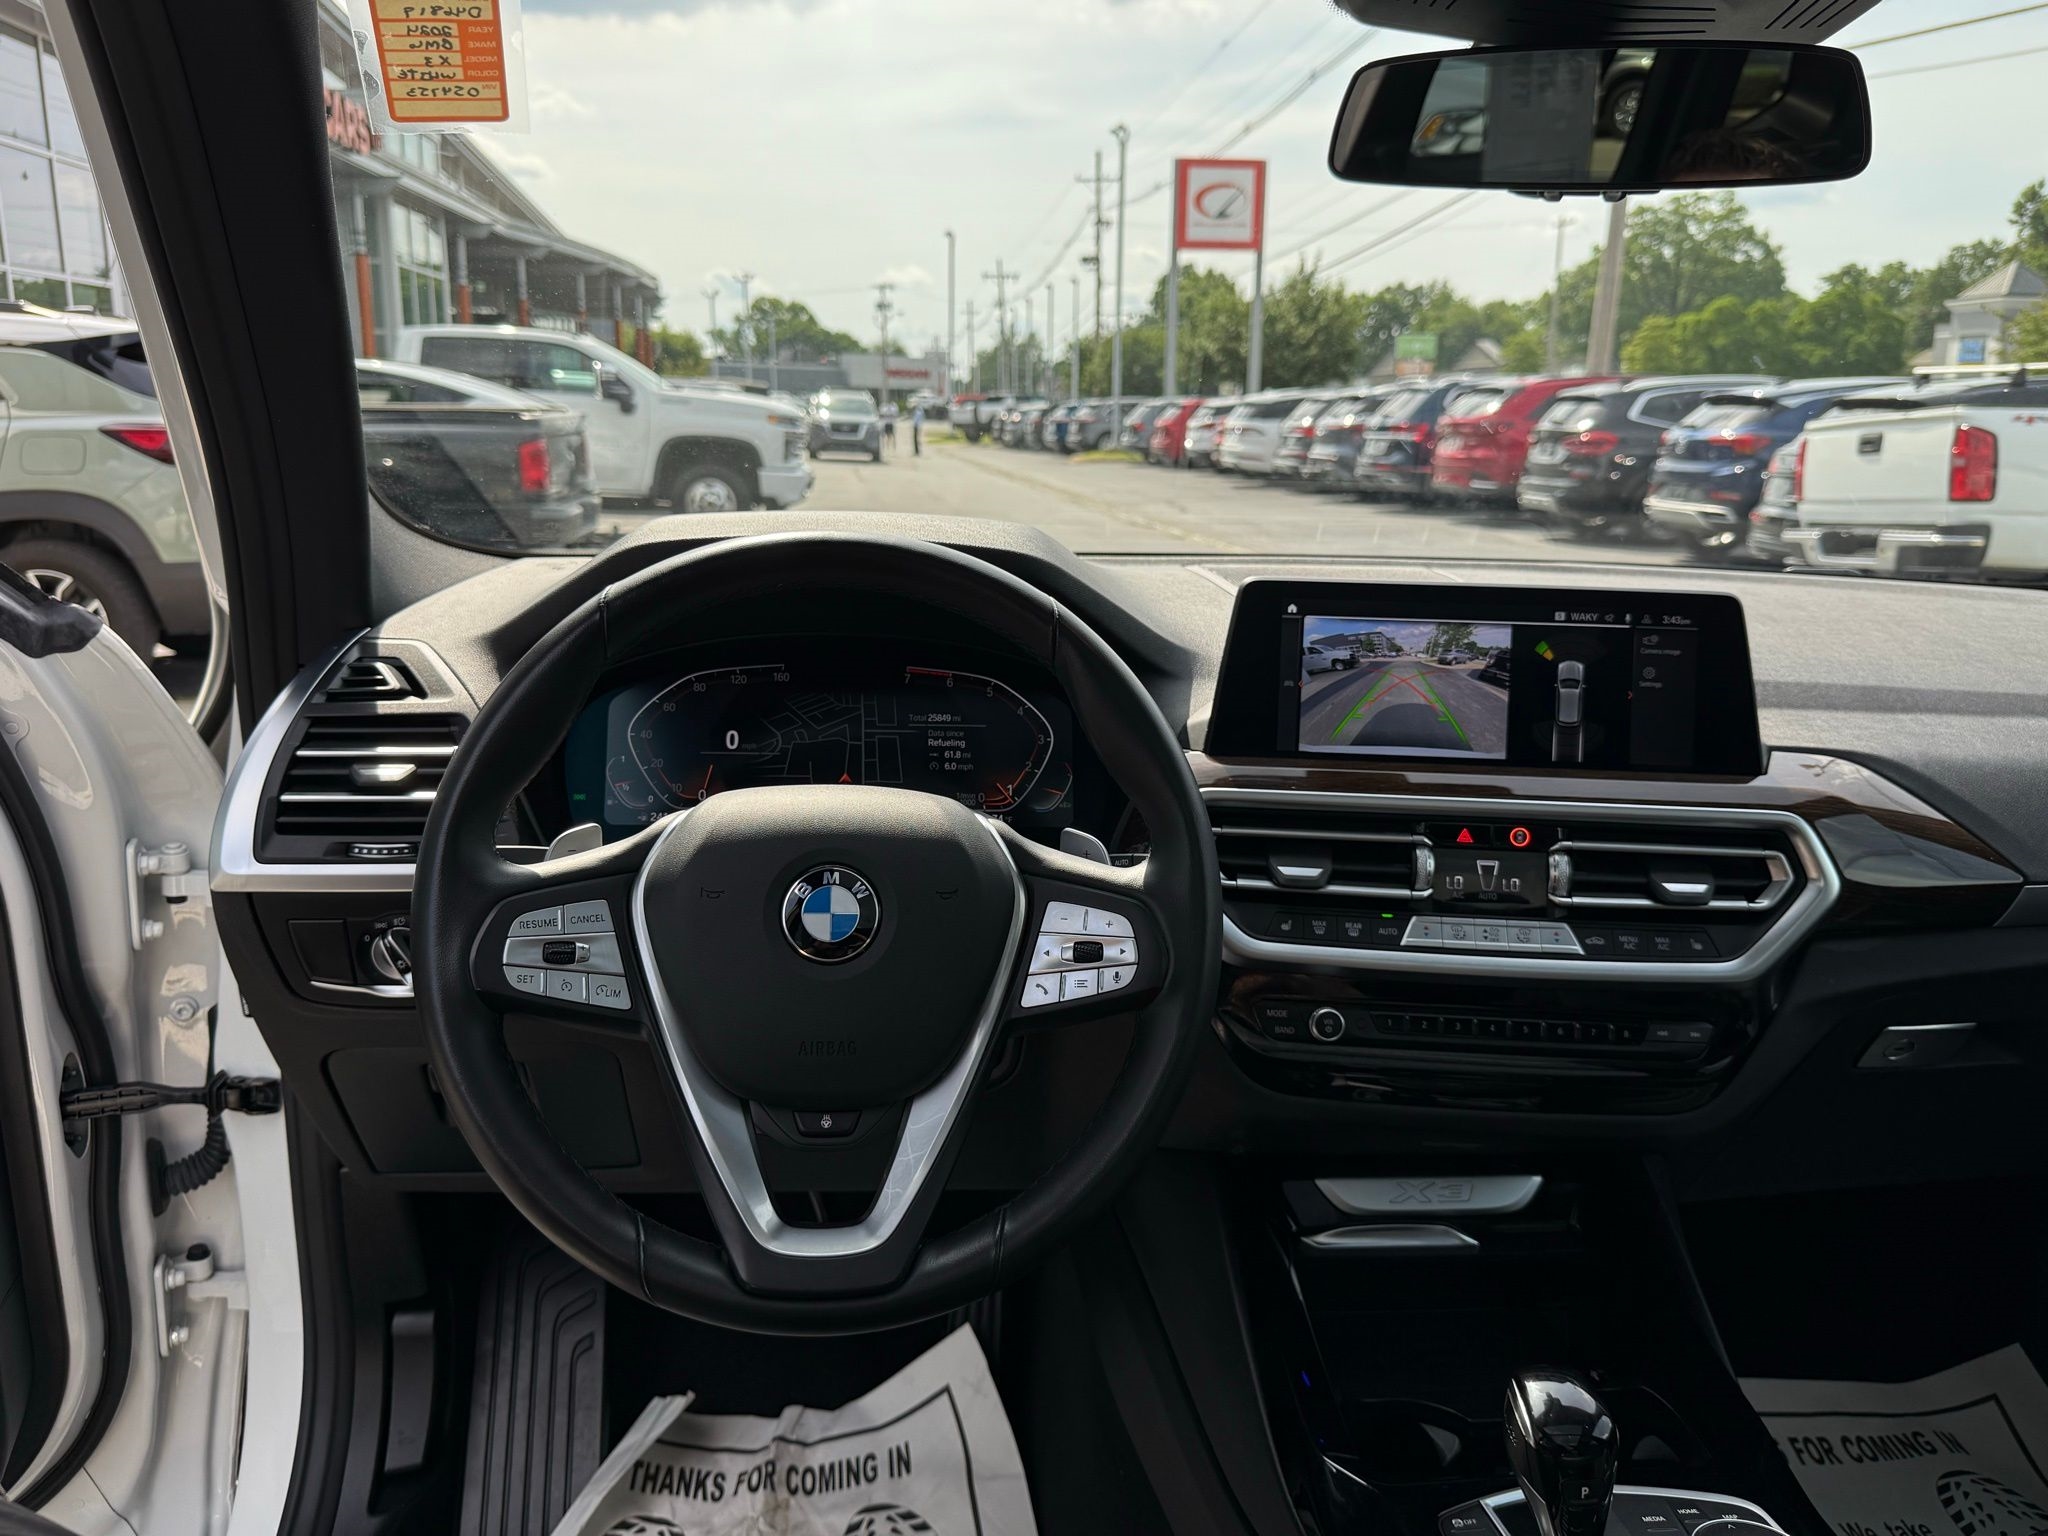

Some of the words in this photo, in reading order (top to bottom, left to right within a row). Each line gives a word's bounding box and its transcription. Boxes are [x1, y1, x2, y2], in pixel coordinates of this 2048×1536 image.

[1570, 612, 1597, 621] WAKY
[730, 675, 747, 684] 120
[773, 673, 790, 682] 160
[905, 674, 911, 684] 7
[693, 682, 706, 692] 80
[946, 679, 954, 687] 6
[986, 687, 994, 697] 5
[663, 703, 676, 712] 60
[1017, 706, 1024, 715] 4
[928, 713, 952, 722] 25849
[640, 730, 653, 739] 40
[725, 730, 740, 749] 0
[1037, 735, 1045, 744] 3
[928, 738, 966, 748] Refueling
[650, 758, 664, 768] 20
[944, 762, 957, 770] 6.0
[1025, 762, 1032, 770] 2
[672, 783, 682, 792] 10
[978, 793, 985, 803] 0
[794, 871, 870, 899] BMW
[1446, 876, 1463, 889] LO
[1502, 878, 1519, 892] LO
[519, 918, 558, 929] RESUME
[570, 914, 606, 925] CANCEL
[1378, 927, 1397, 935] AUTO
[516, 974, 535, 984] SET
[605, 989, 621, 998] LIM
[1266, 1009, 1288, 1017] MODE
[1274, 1026, 1295, 1034] BAND
[798, 1040, 857, 1056] AIRBAG
[1389, 1181, 1474, 1203] X3
[1787, 1436, 1843, 1466] FOR
[1841, 1430, 1938, 1464] COMING
[1932, 1429, 1971, 1456] IN
[629, 1459, 725, 1502] THANKS
[733, 1460, 776, 1498] FOR
[785, 1452, 877, 1496] COMING
[889, 1440, 912, 1478] IN
[1580, 1486, 1589, 1499] P
